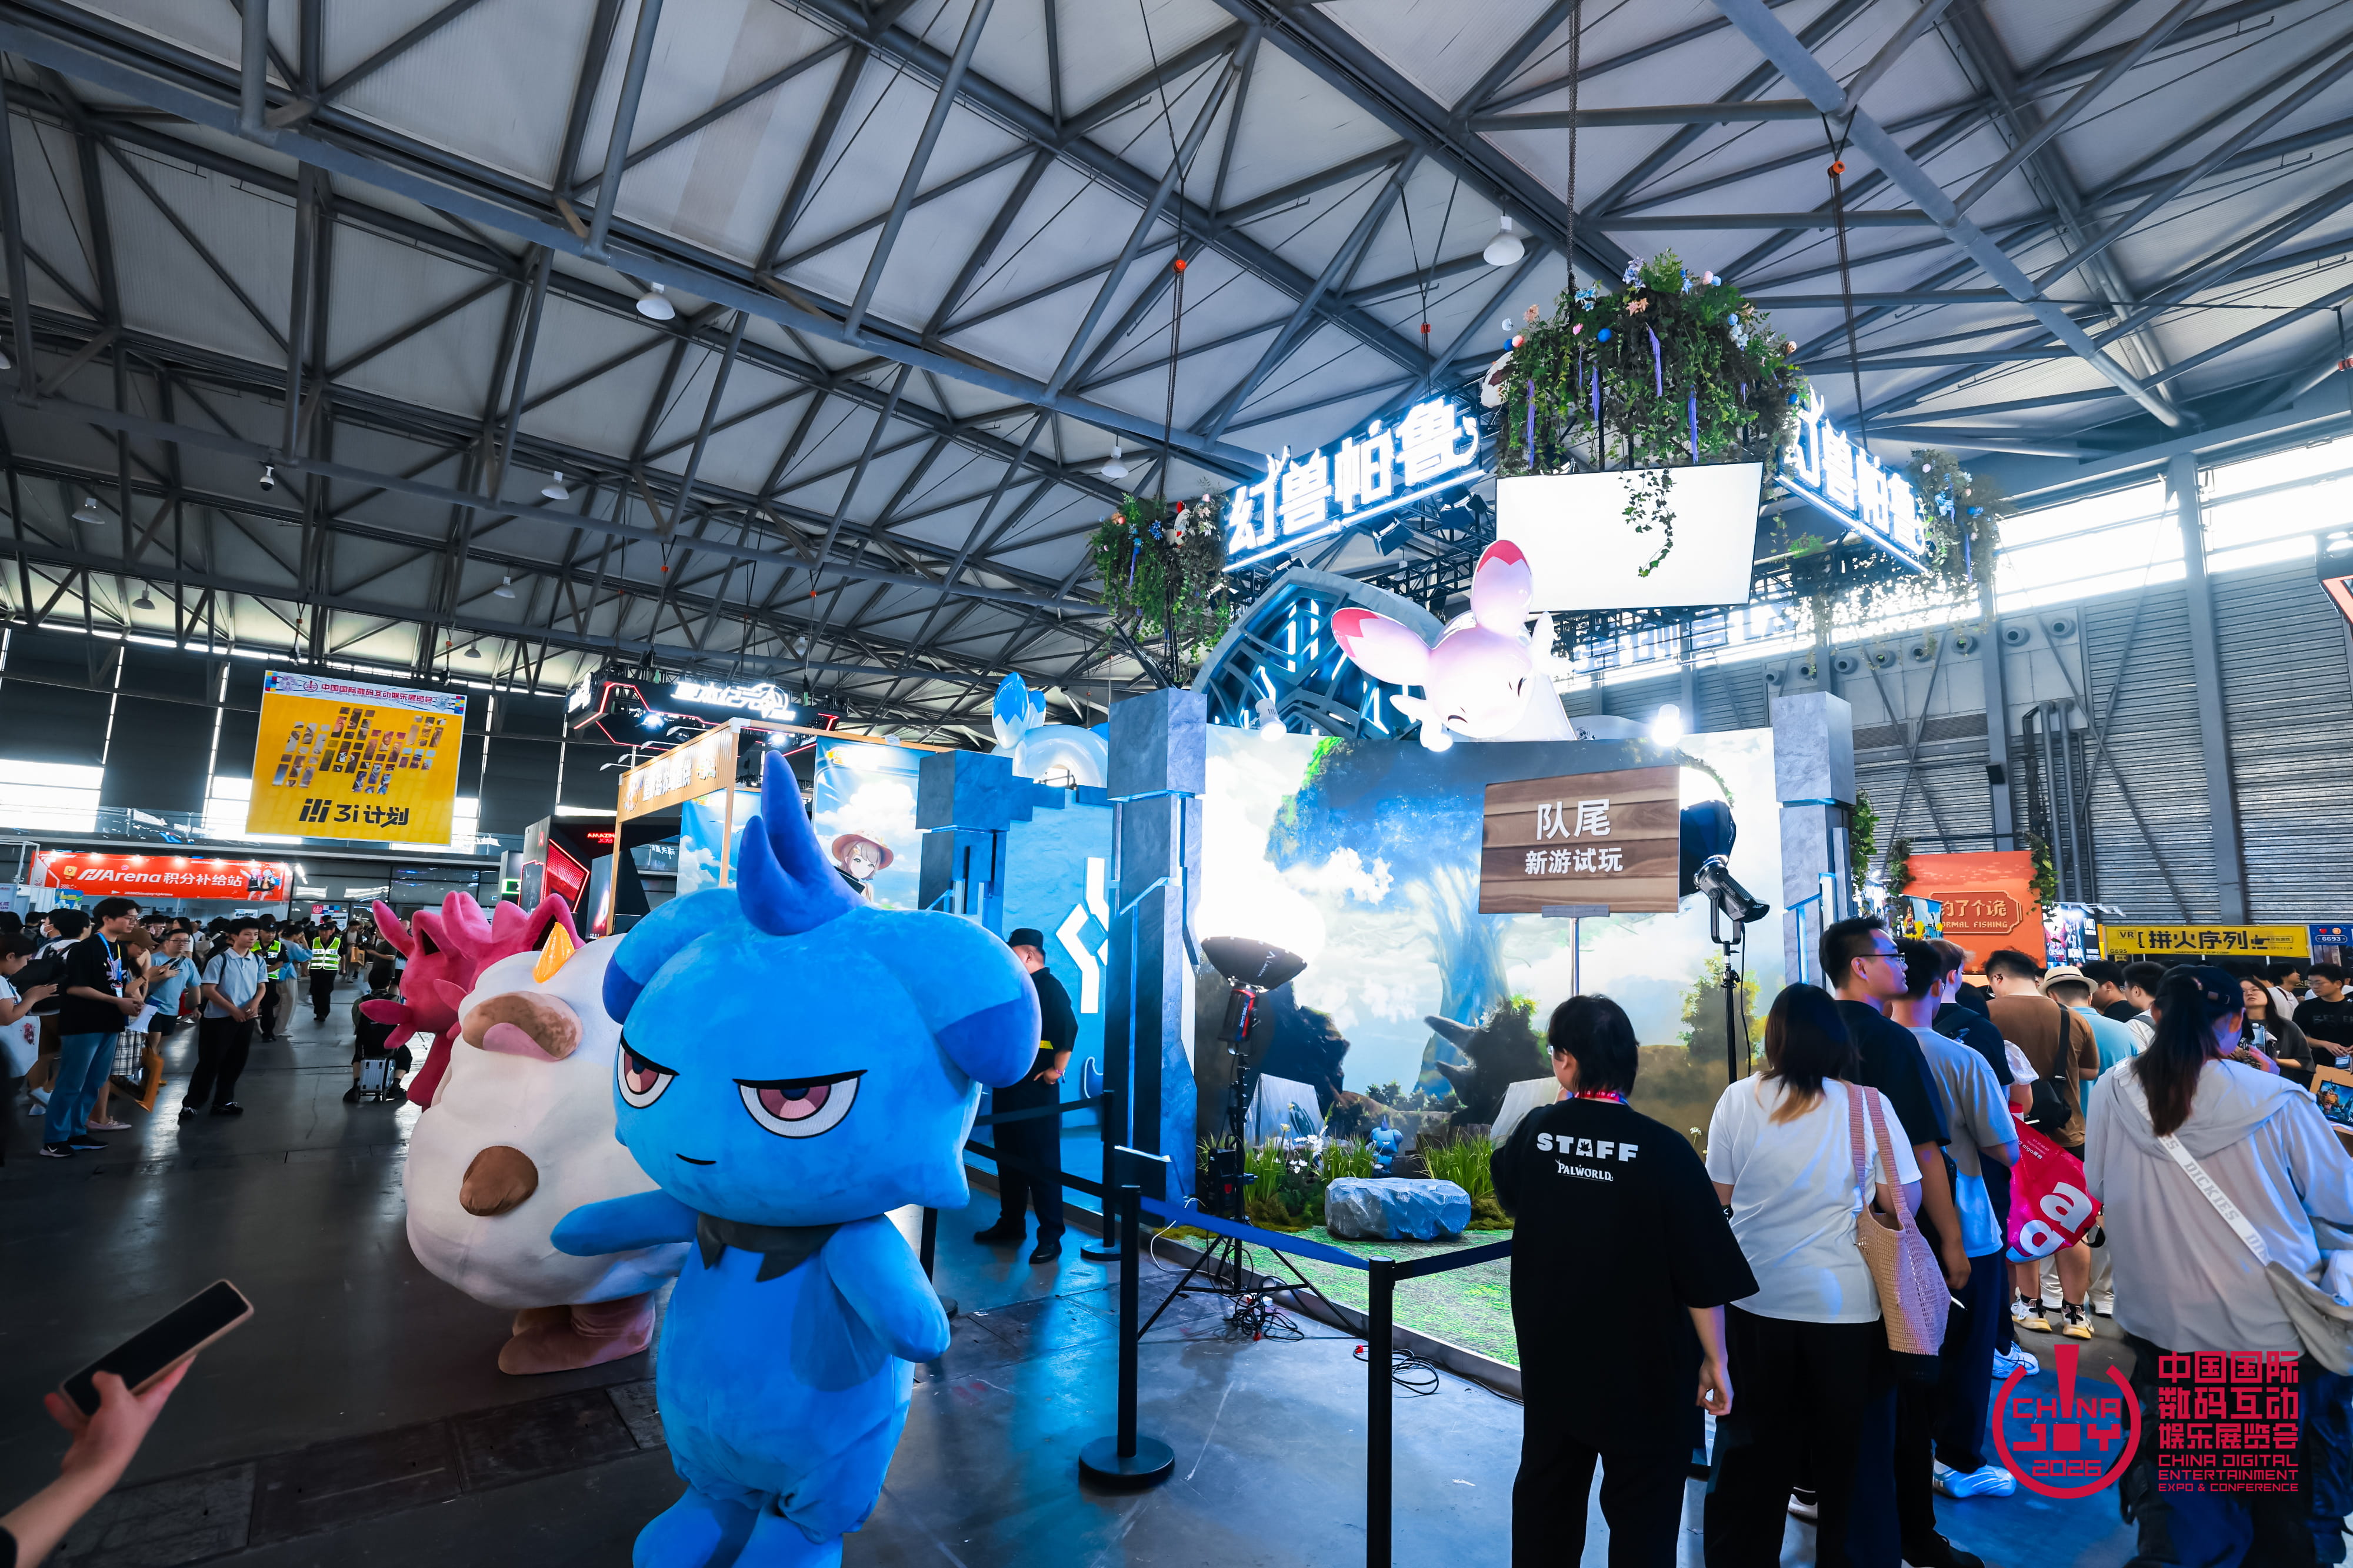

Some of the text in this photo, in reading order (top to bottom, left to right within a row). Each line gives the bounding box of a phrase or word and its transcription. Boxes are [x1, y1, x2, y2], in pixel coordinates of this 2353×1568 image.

[1227, 396, 1480, 555] 幻兽帕鲁
[1786, 383, 1925, 555] 幻兽帕鲁
[321, 683, 433, 703] 中国国际数码互动娱乐展览会
[1537, 798, 1611, 840] 队尾
[1525, 848, 1623, 875] 新游试玩
[164, 872, 242, 887] 积分补给站
[1537, 1133, 1638, 1162] STAFF
[1555, 1159, 1614, 1182] PALWORLD
[2184, 1161, 2240, 1221] DICKIES
